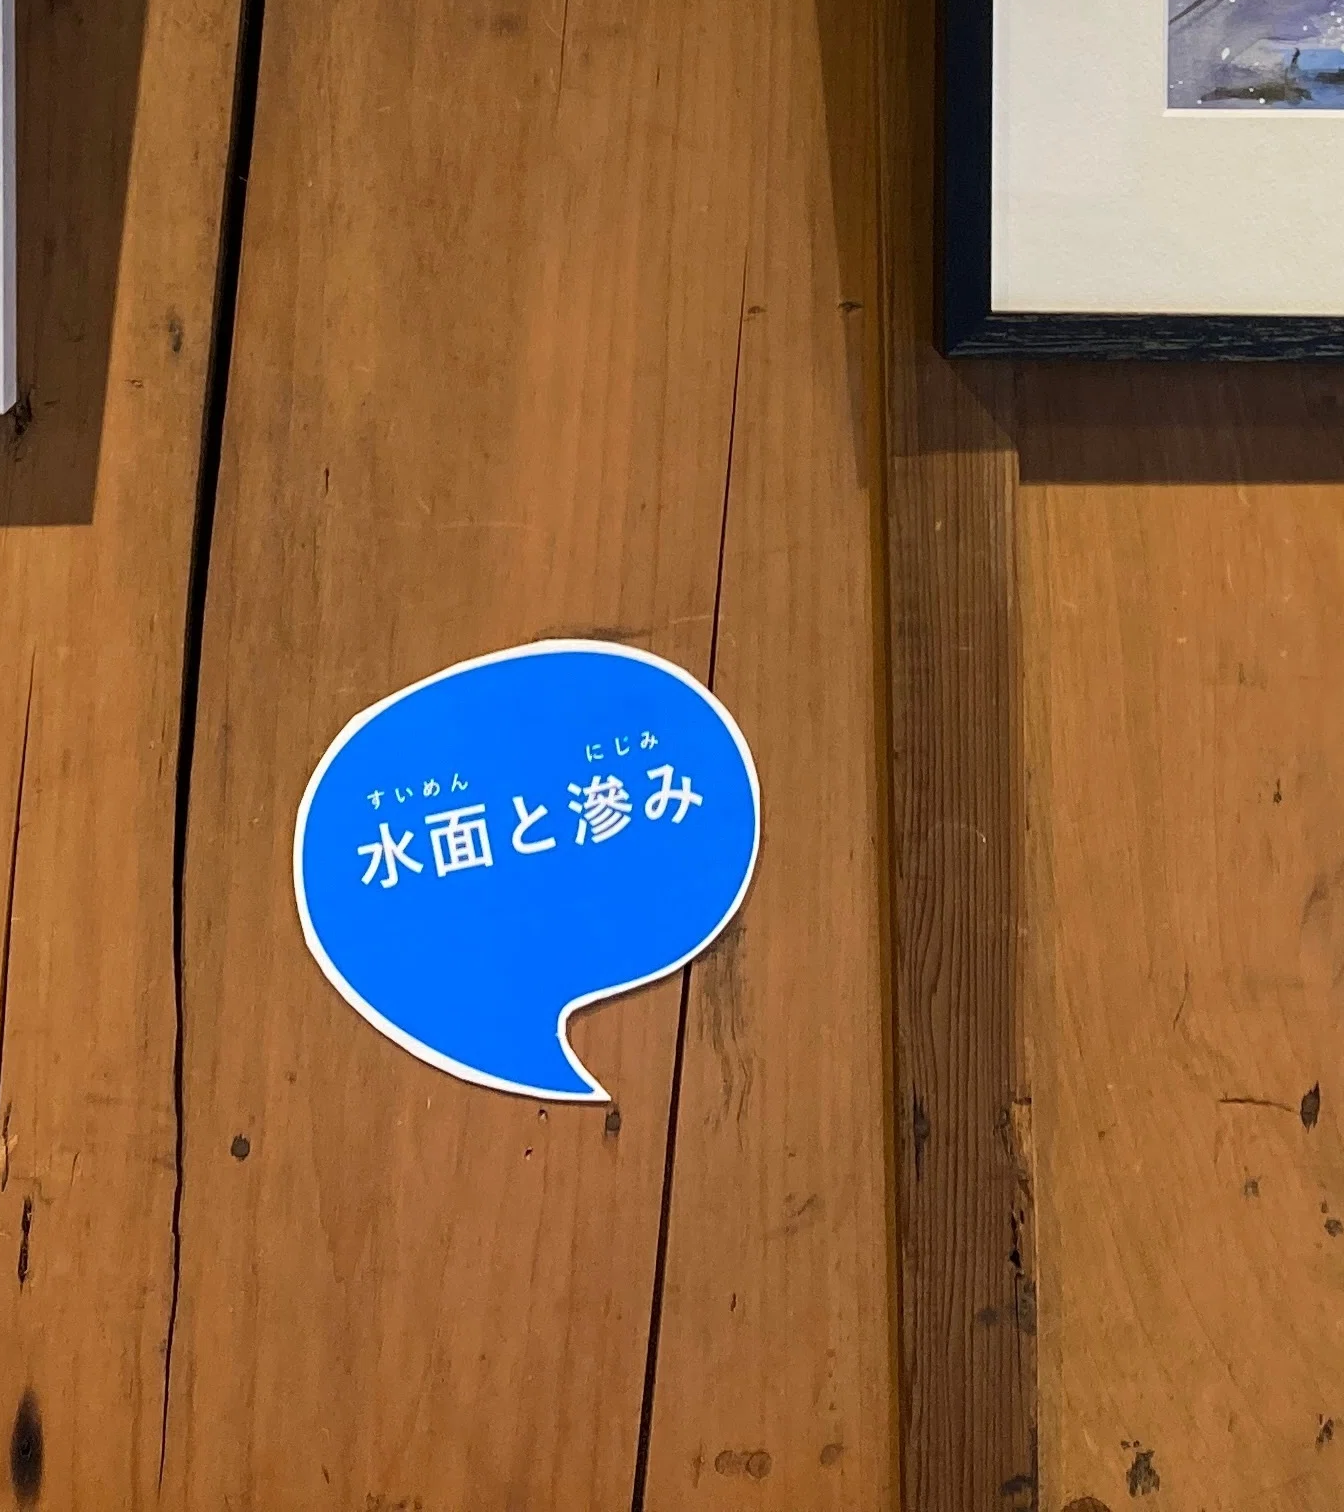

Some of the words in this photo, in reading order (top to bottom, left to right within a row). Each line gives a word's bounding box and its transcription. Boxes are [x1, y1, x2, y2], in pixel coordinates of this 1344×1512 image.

[584, 729, 660, 763] にじみ
[366, 771, 471, 811] すいめん
[356, 763, 705, 891] 水面と滲み
